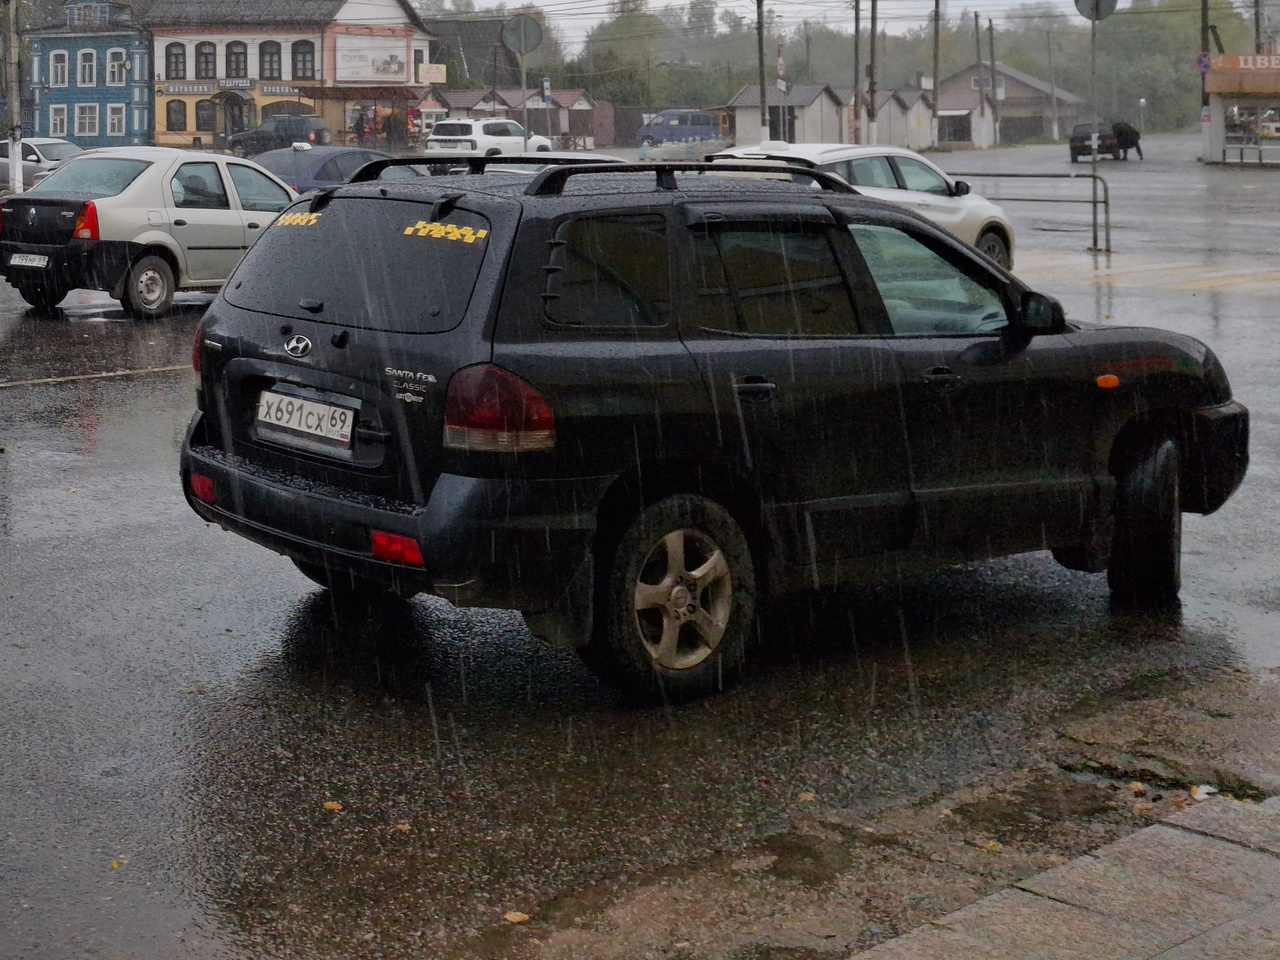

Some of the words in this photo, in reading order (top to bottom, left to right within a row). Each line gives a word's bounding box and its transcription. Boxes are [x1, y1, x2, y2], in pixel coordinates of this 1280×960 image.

[385, 367, 415, 380] SANTA
[392, 380, 427, 393] CLASSIC
[329, 409, 347, 430] 69
[327, 427, 340, 437] RUS
